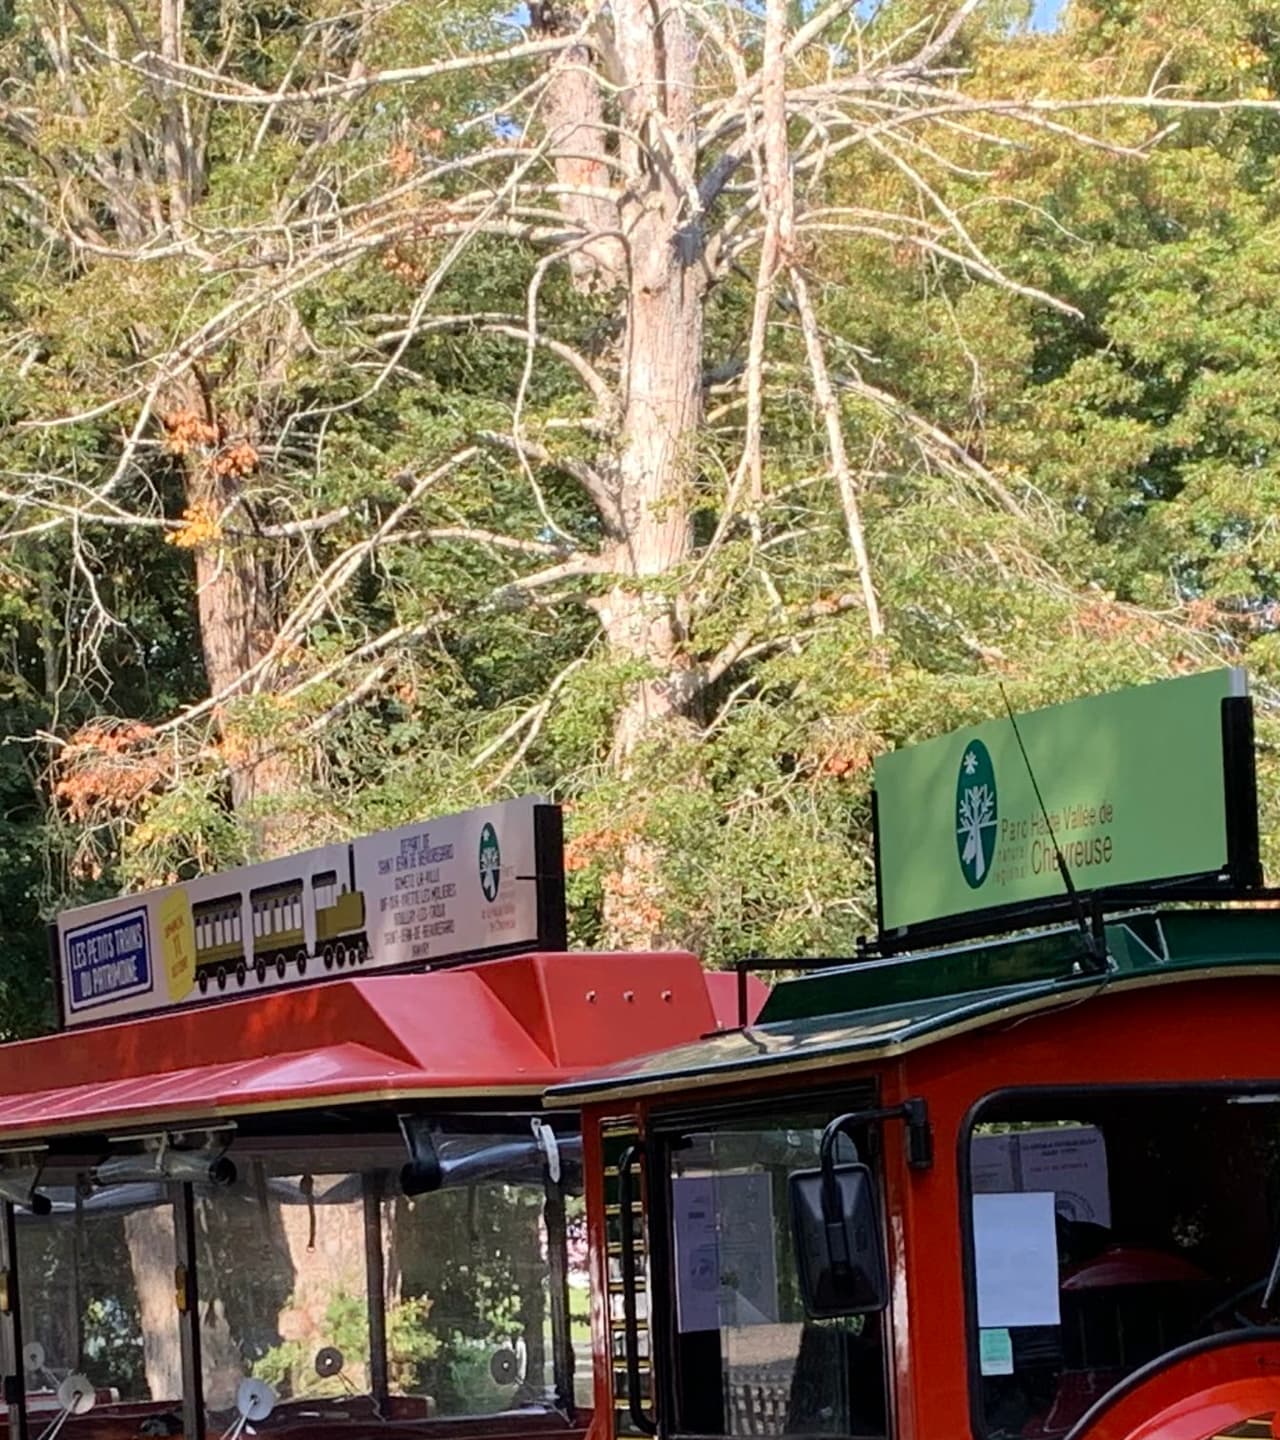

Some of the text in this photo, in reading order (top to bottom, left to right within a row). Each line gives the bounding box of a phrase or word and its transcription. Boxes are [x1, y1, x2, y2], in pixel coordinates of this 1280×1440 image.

[1001, 800, 1113, 842] Parc Hate Vallée de
[1031, 834, 1113, 875] Chevreuse
[72, 941, 88, 970] LES
[87, 932, 115, 965] PETITS
[114, 922, 143, 956] TRAINS
